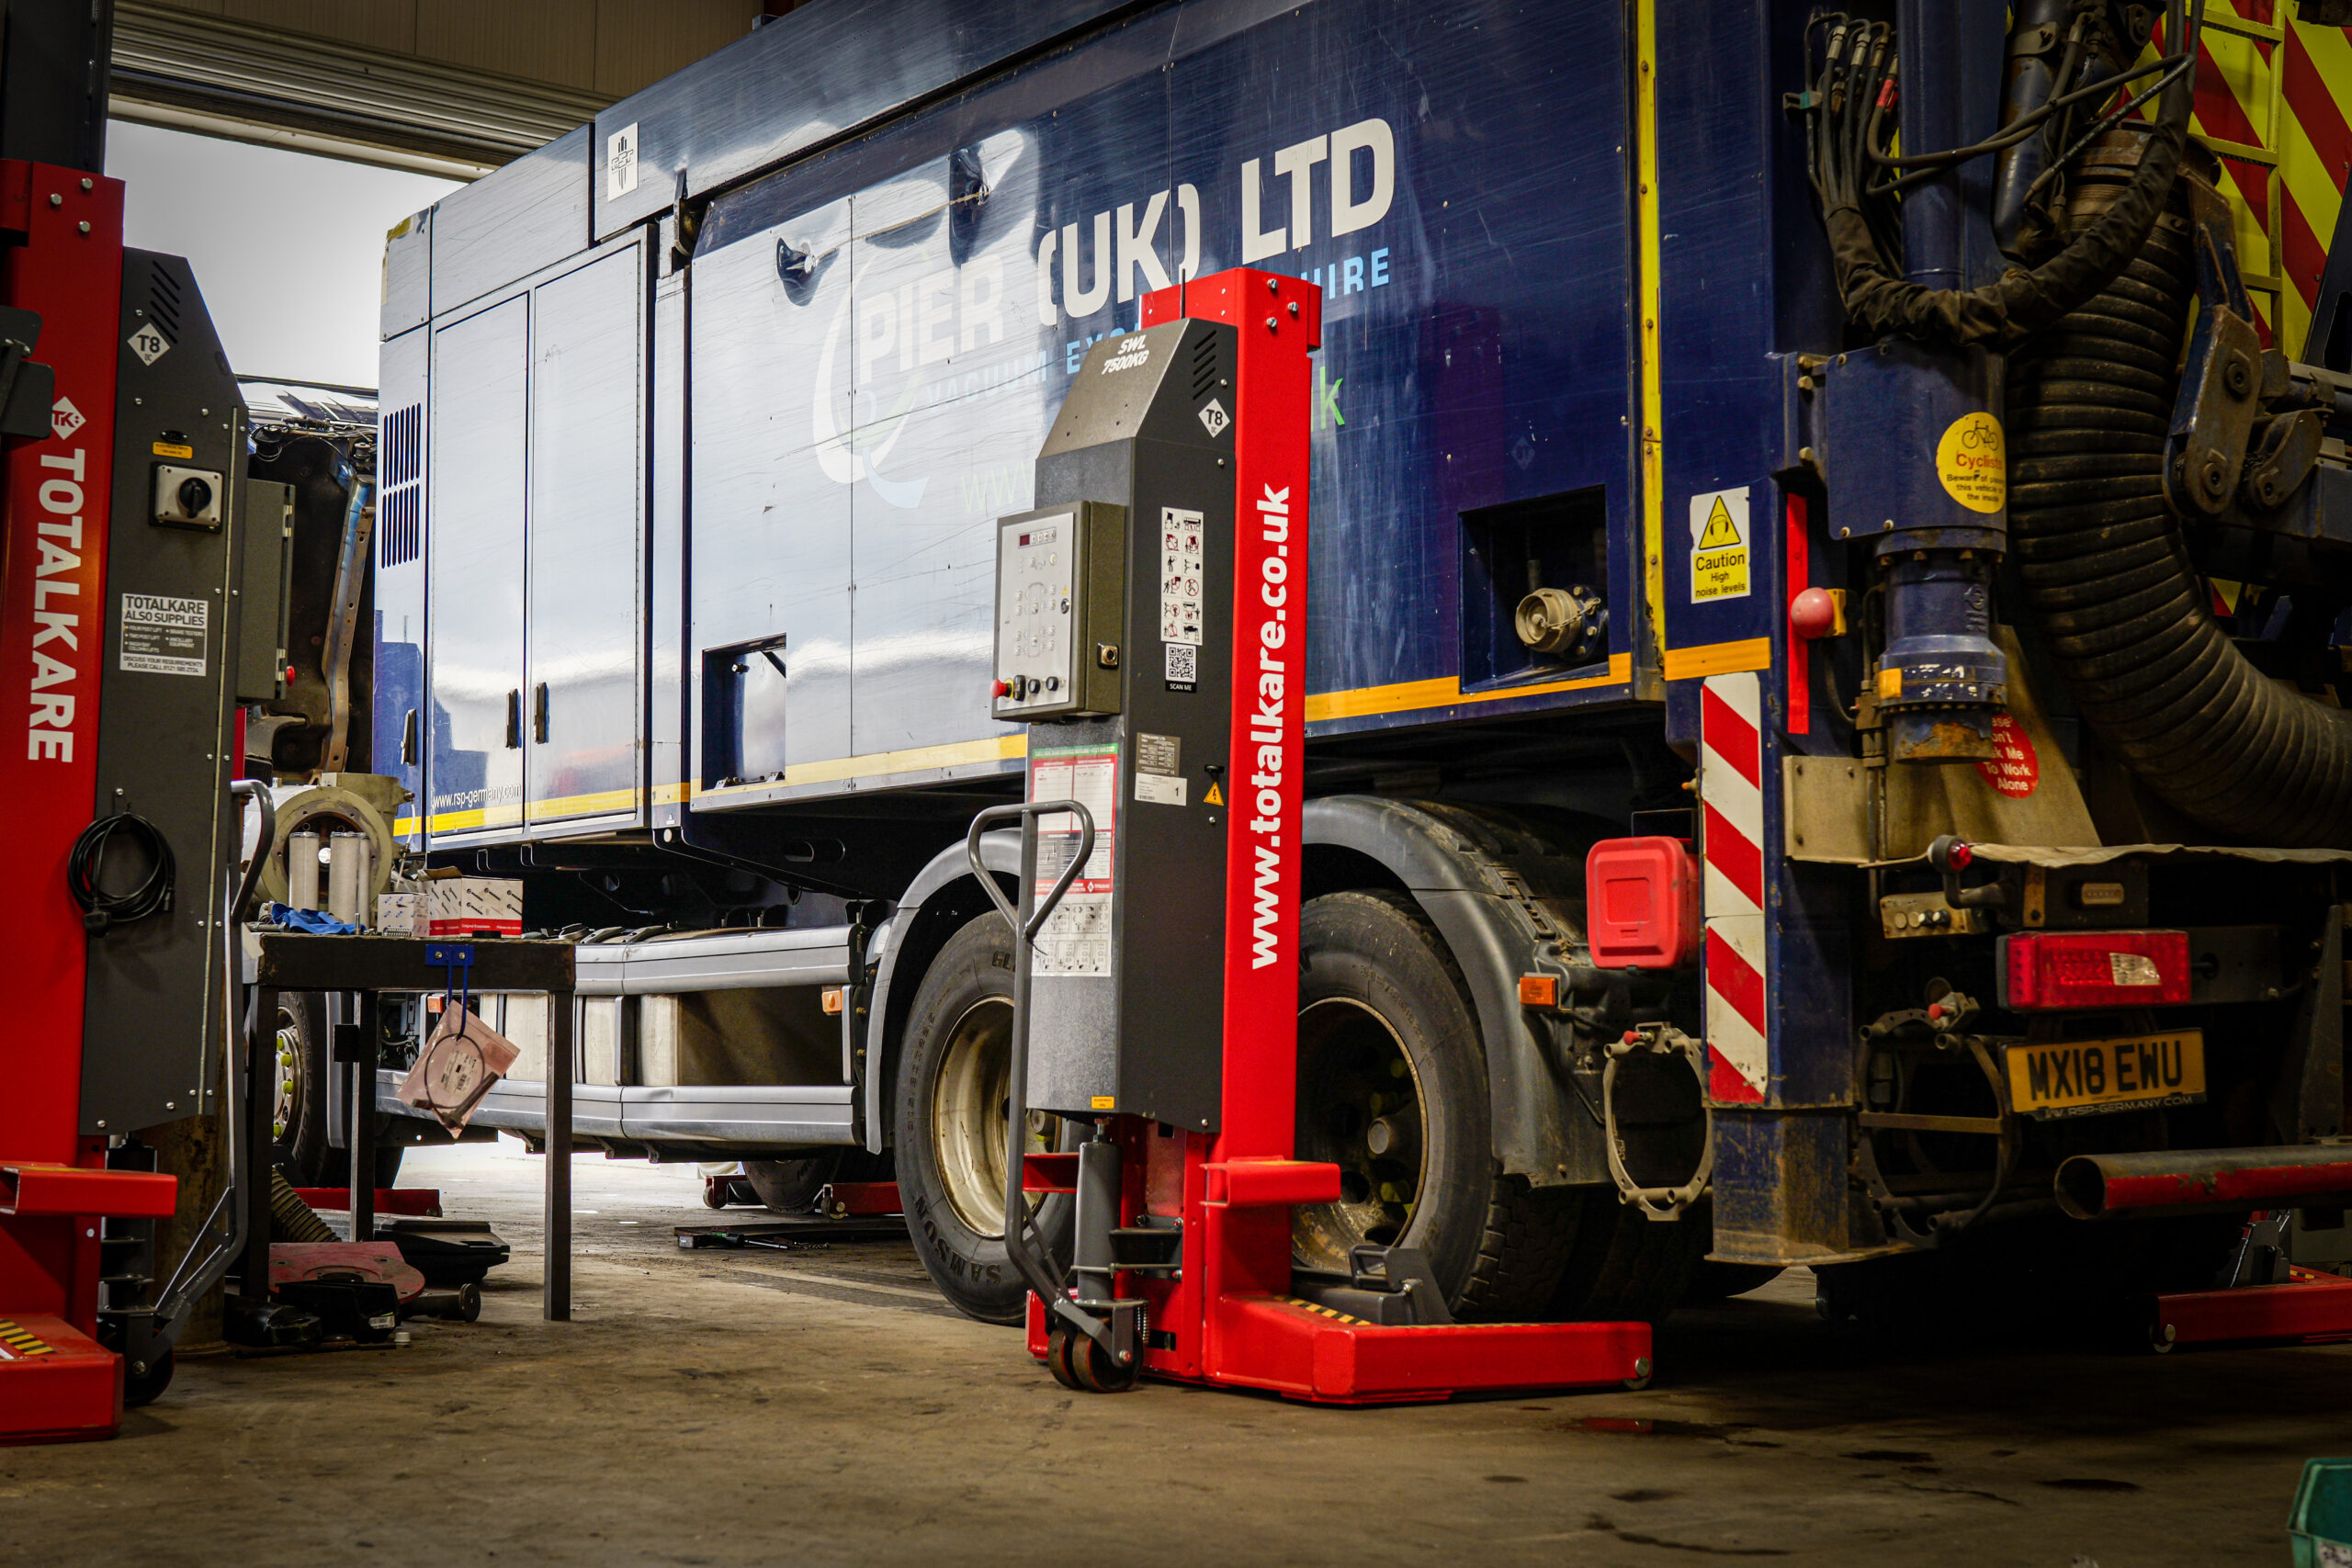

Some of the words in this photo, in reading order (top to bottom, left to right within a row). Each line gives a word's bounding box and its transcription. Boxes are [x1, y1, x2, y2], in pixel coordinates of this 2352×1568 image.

[860, 254, 1003, 385] PIER
[1037, 184, 1201, 326] (UK)
[1242, 118, 1395, 265] LTD
[137, 334, 161, 354] T8
[1117, 334, 1147, 355] SWL
[1101, 350, 1150, 376] 7500KG
[926, 350, 1047, 412] VACUUM
[1205, 408, 1223, 426] T8
[1696, 553, 1745, 570] Caution
[1711, 571, 1730, 583] High
[1695, 587, 1718, 597] noise
[1721, 581, 1746, 593] levels
[28, 448, 85, 763] TOTALKARE
[125, 595, 205, 615] TOTALKARE
[125, 610, 153, 622] ALSO
[154, 613, 205, 626] SUPPLIES
[1250, 483, 1290, 970] www.totalkare.co.uk
[1992, 731, 2013, 743] on't
[2005, 746, 2024, 761] Me
[1983, 761, 1998, 774] To
[2000, 763, 2032, 776] Work
[1997, 777, 2029, 791] Alone
[433, 784, 522, 808] www.rsp-germany.com
[2028, 1047, 2106, 1101] MX18
[2115, 1040, 2183, 1092] EWU
[912, 1194, 1002, 1287] SAMSON
